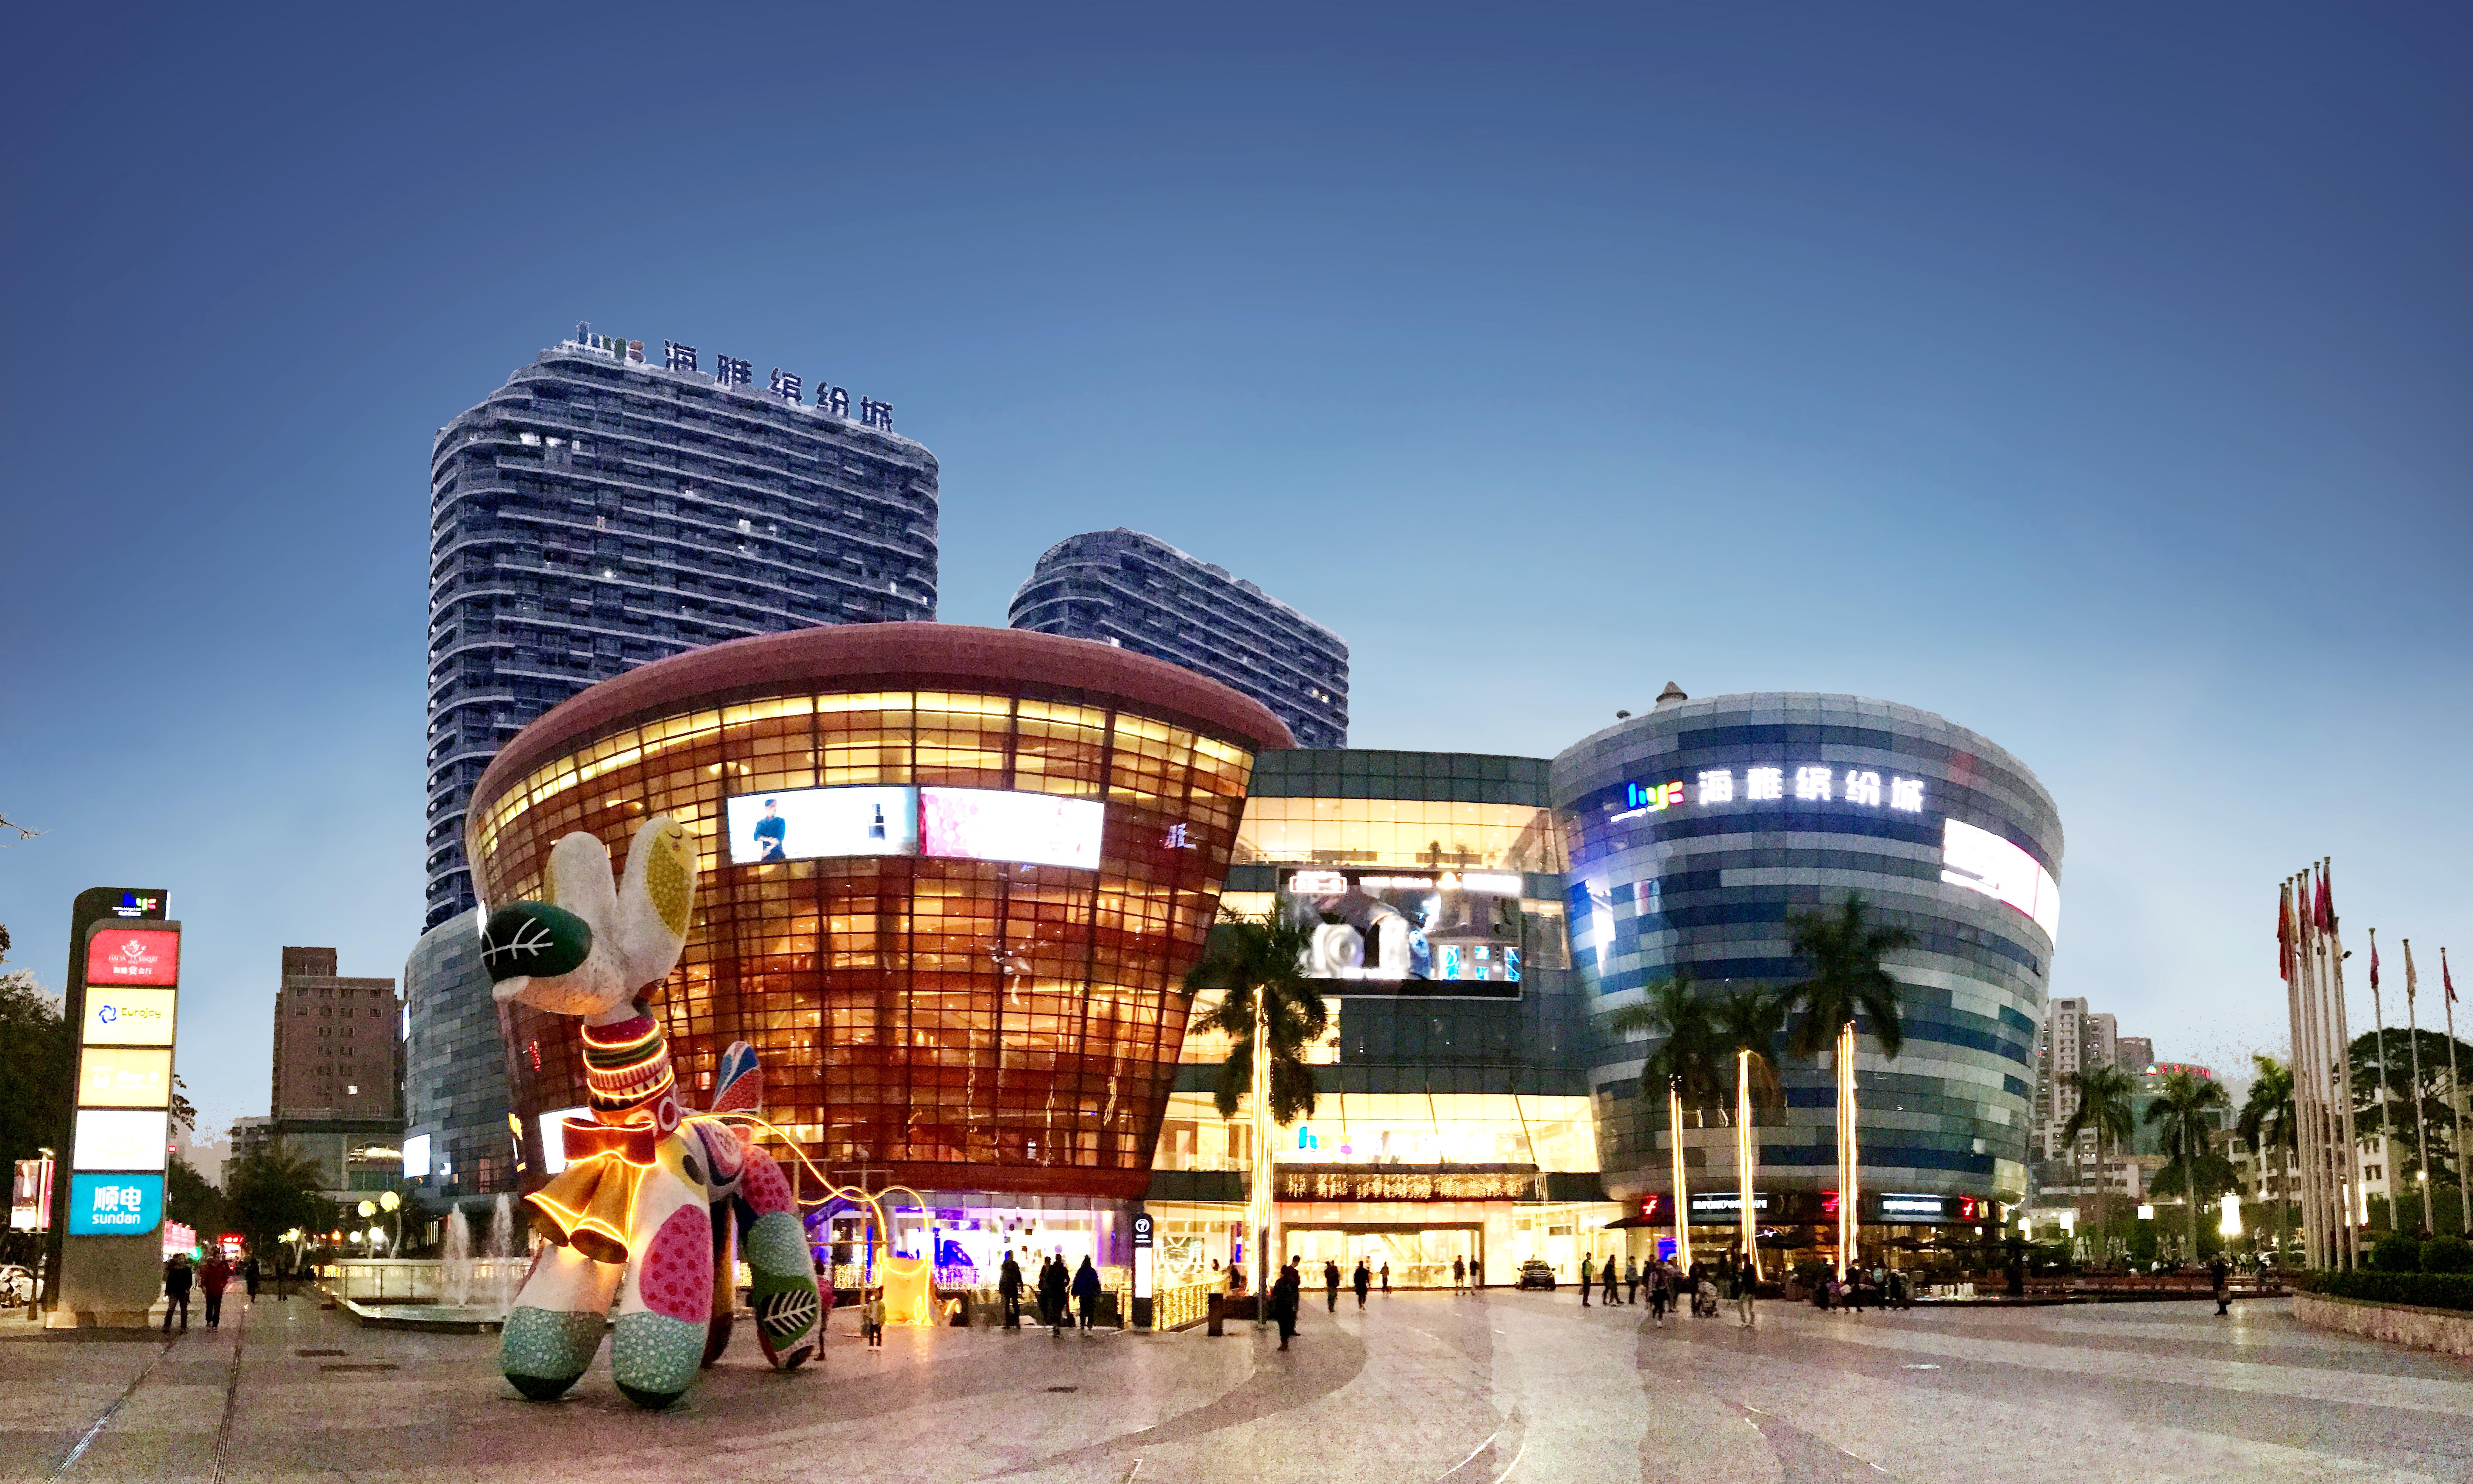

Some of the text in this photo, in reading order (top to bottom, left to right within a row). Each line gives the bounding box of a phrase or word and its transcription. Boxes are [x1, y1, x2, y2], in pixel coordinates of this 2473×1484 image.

[1699, 766, 1924, 812] 海雅缤纷城
[121, 1008, 161, 1018] Eurojoy
[93, 1186, 142, 1211] 顺电
[92, 1210, 140, 1224] sundan
